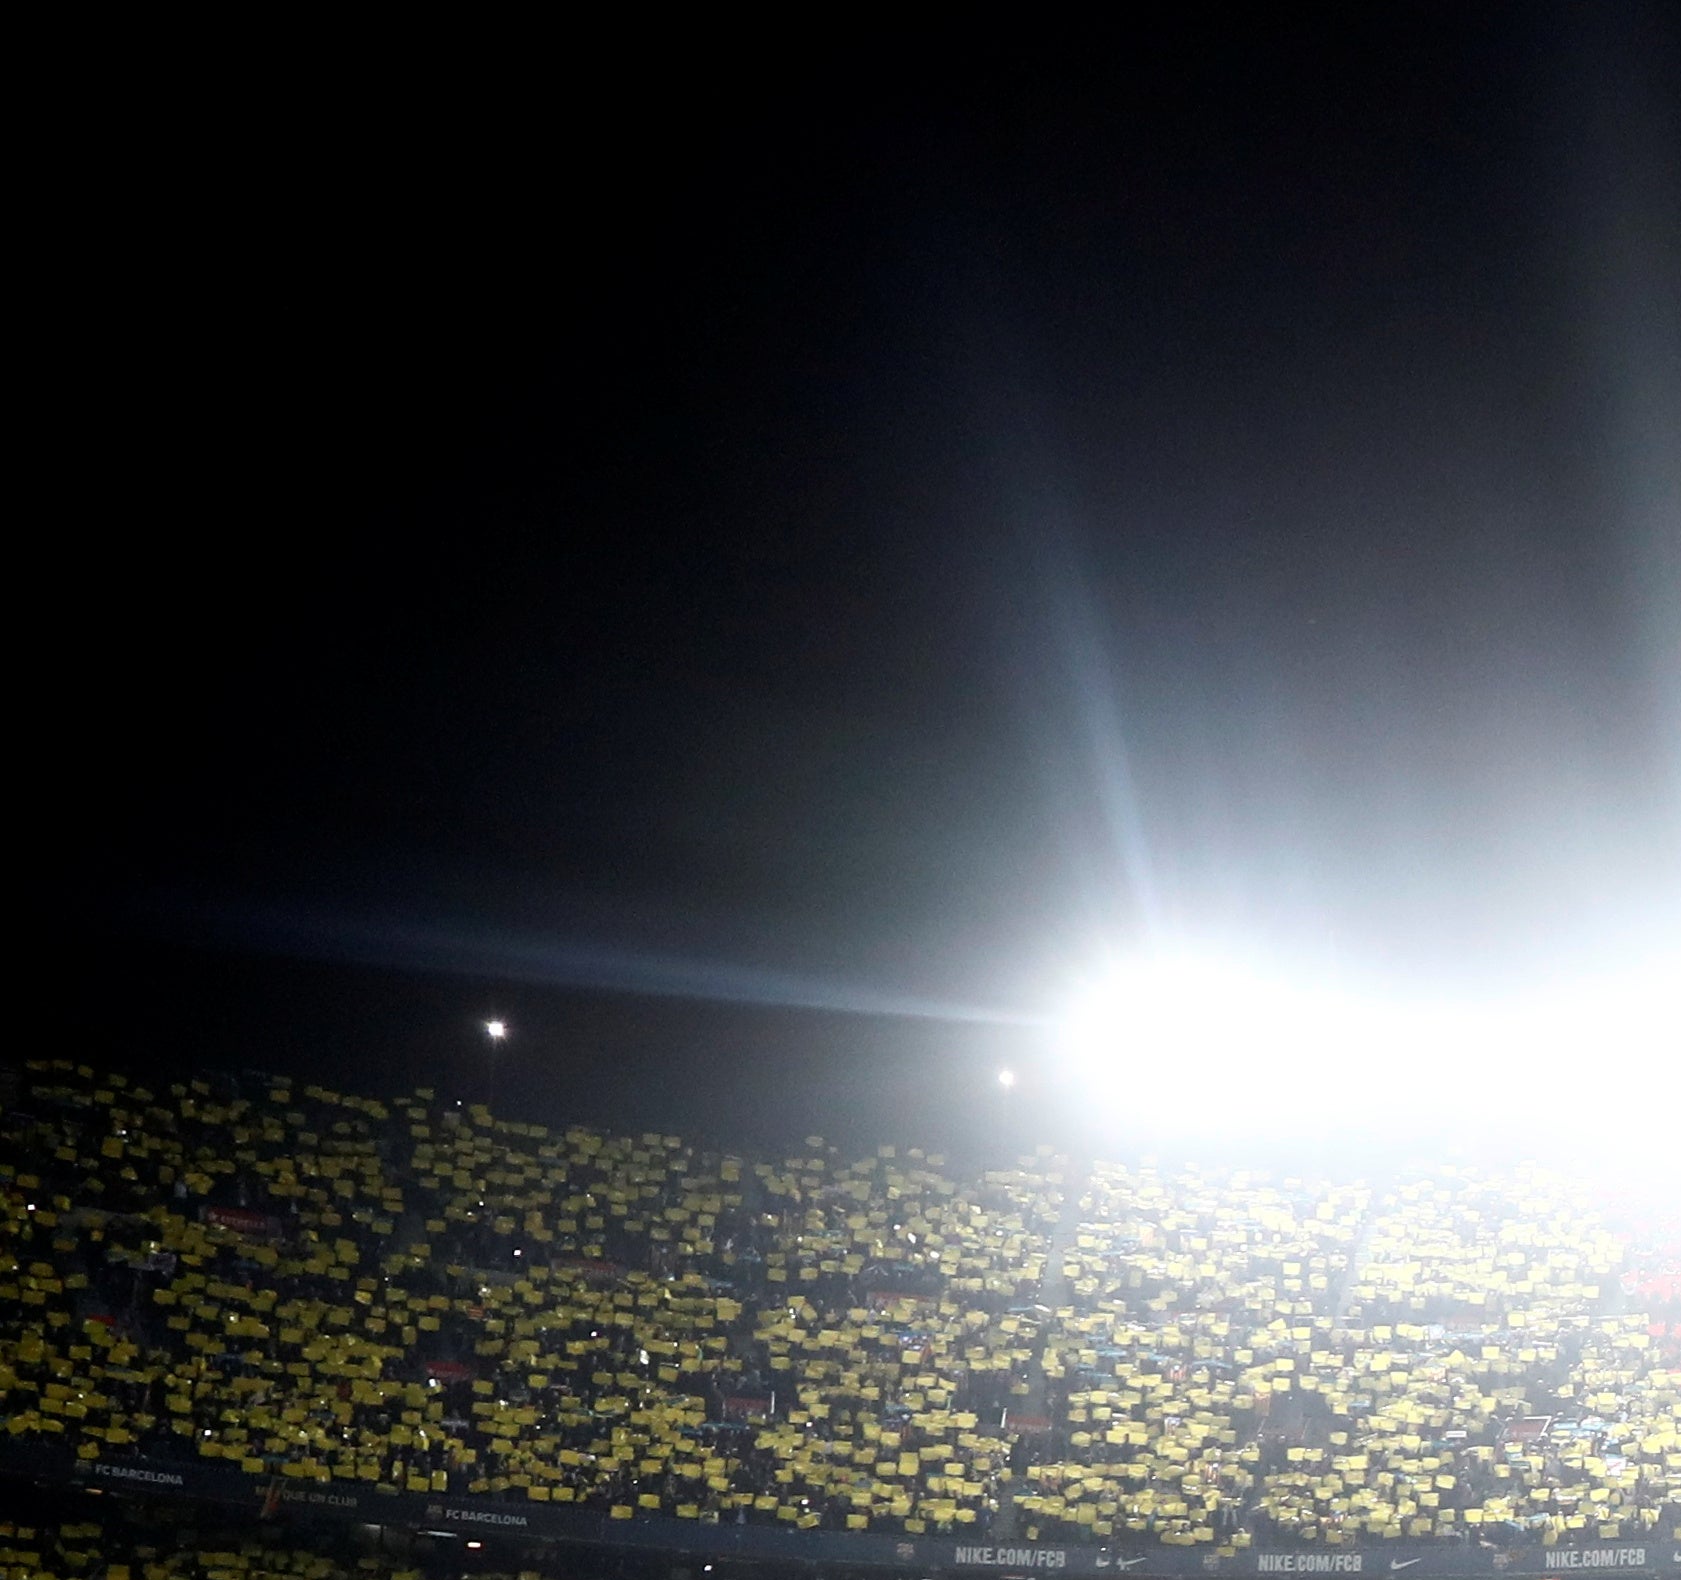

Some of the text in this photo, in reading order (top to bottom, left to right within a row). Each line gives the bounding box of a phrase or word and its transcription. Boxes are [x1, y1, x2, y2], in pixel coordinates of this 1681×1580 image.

[95, 1464, 183, 1485] FC BARCELONA
[446, 1509, 527, 1526] FC BARCELONA
[956, 1547, 1066, 1569] NIKE.COM/FCB
[1258, 1555, 1362, 1573] NIKE.COM/FCB
[1545, 1549, 1646, 1568] NIKE.COM/FCB
